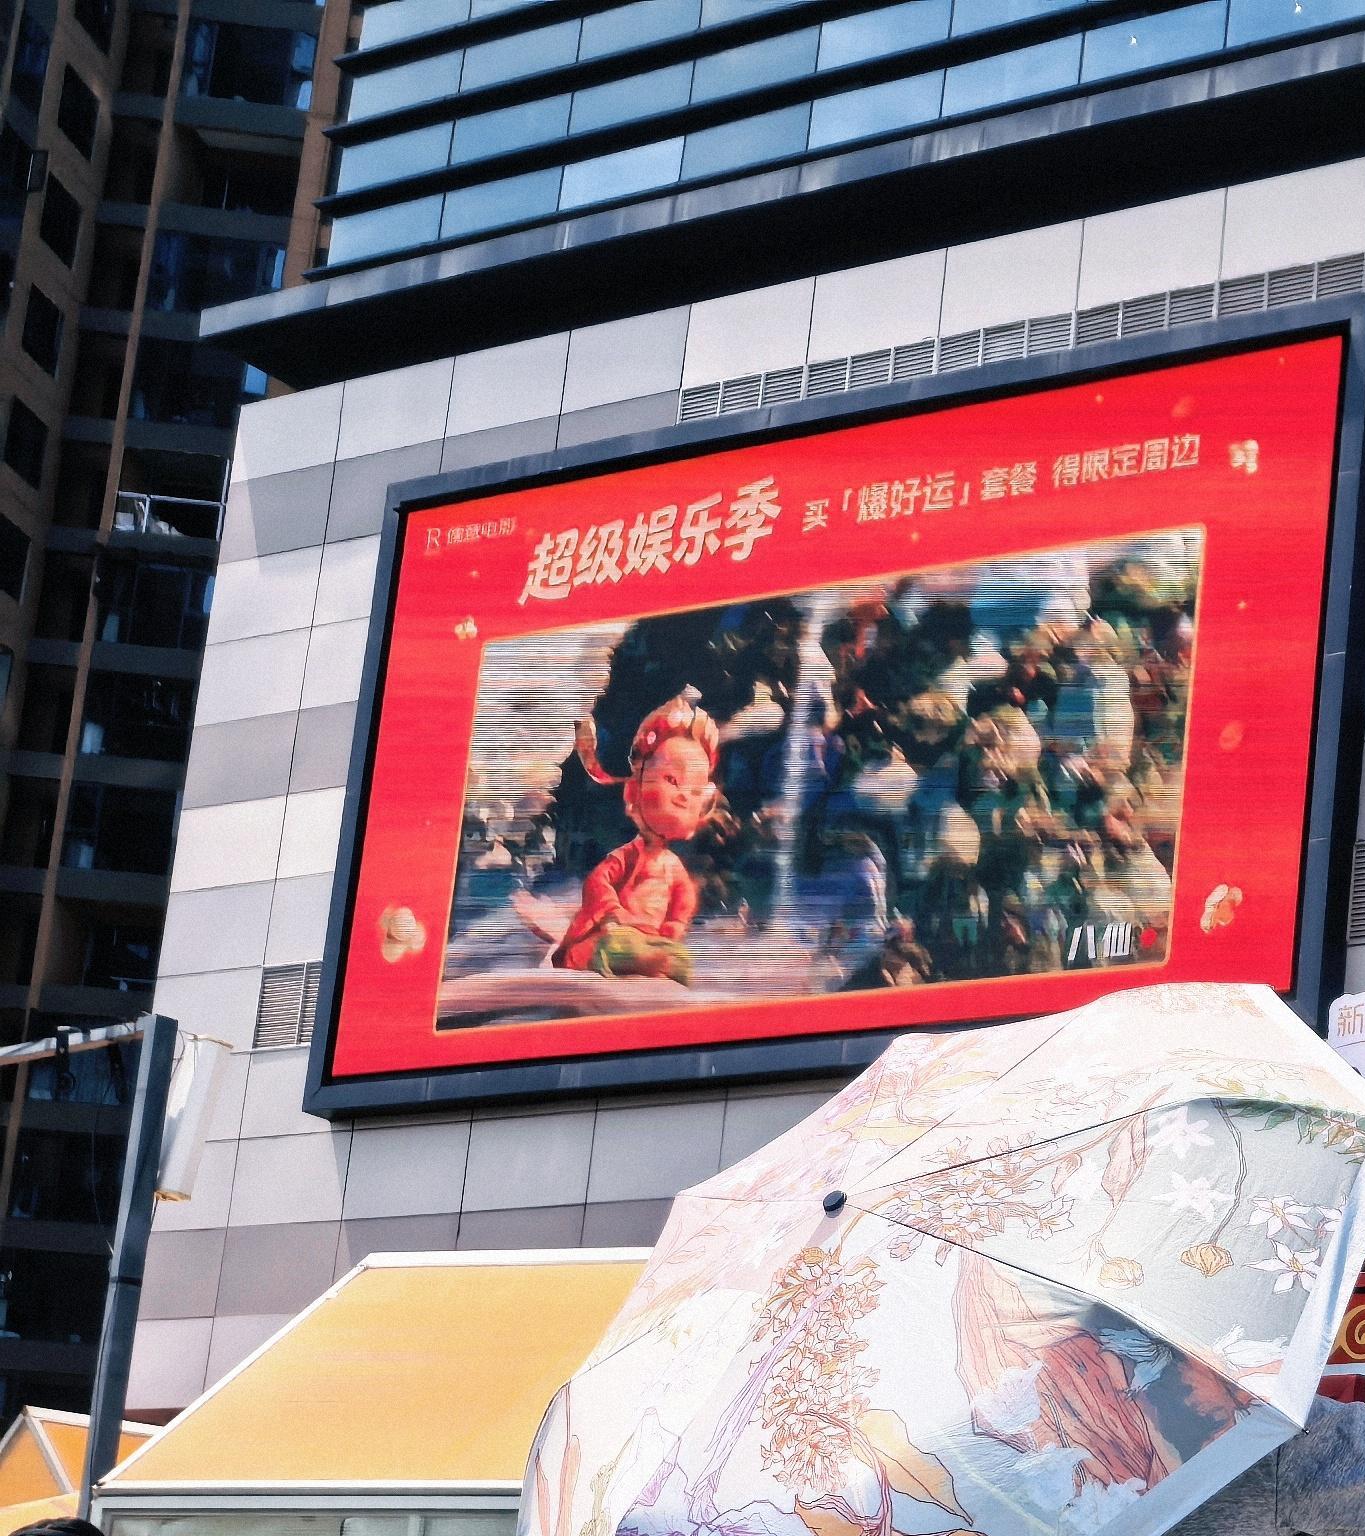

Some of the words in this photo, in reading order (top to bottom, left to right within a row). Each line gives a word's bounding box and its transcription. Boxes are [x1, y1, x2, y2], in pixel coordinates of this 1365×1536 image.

[1052, 433, 1201, 489] 得限定周边
[517, 475, 783, 606] 超级娱乐季
